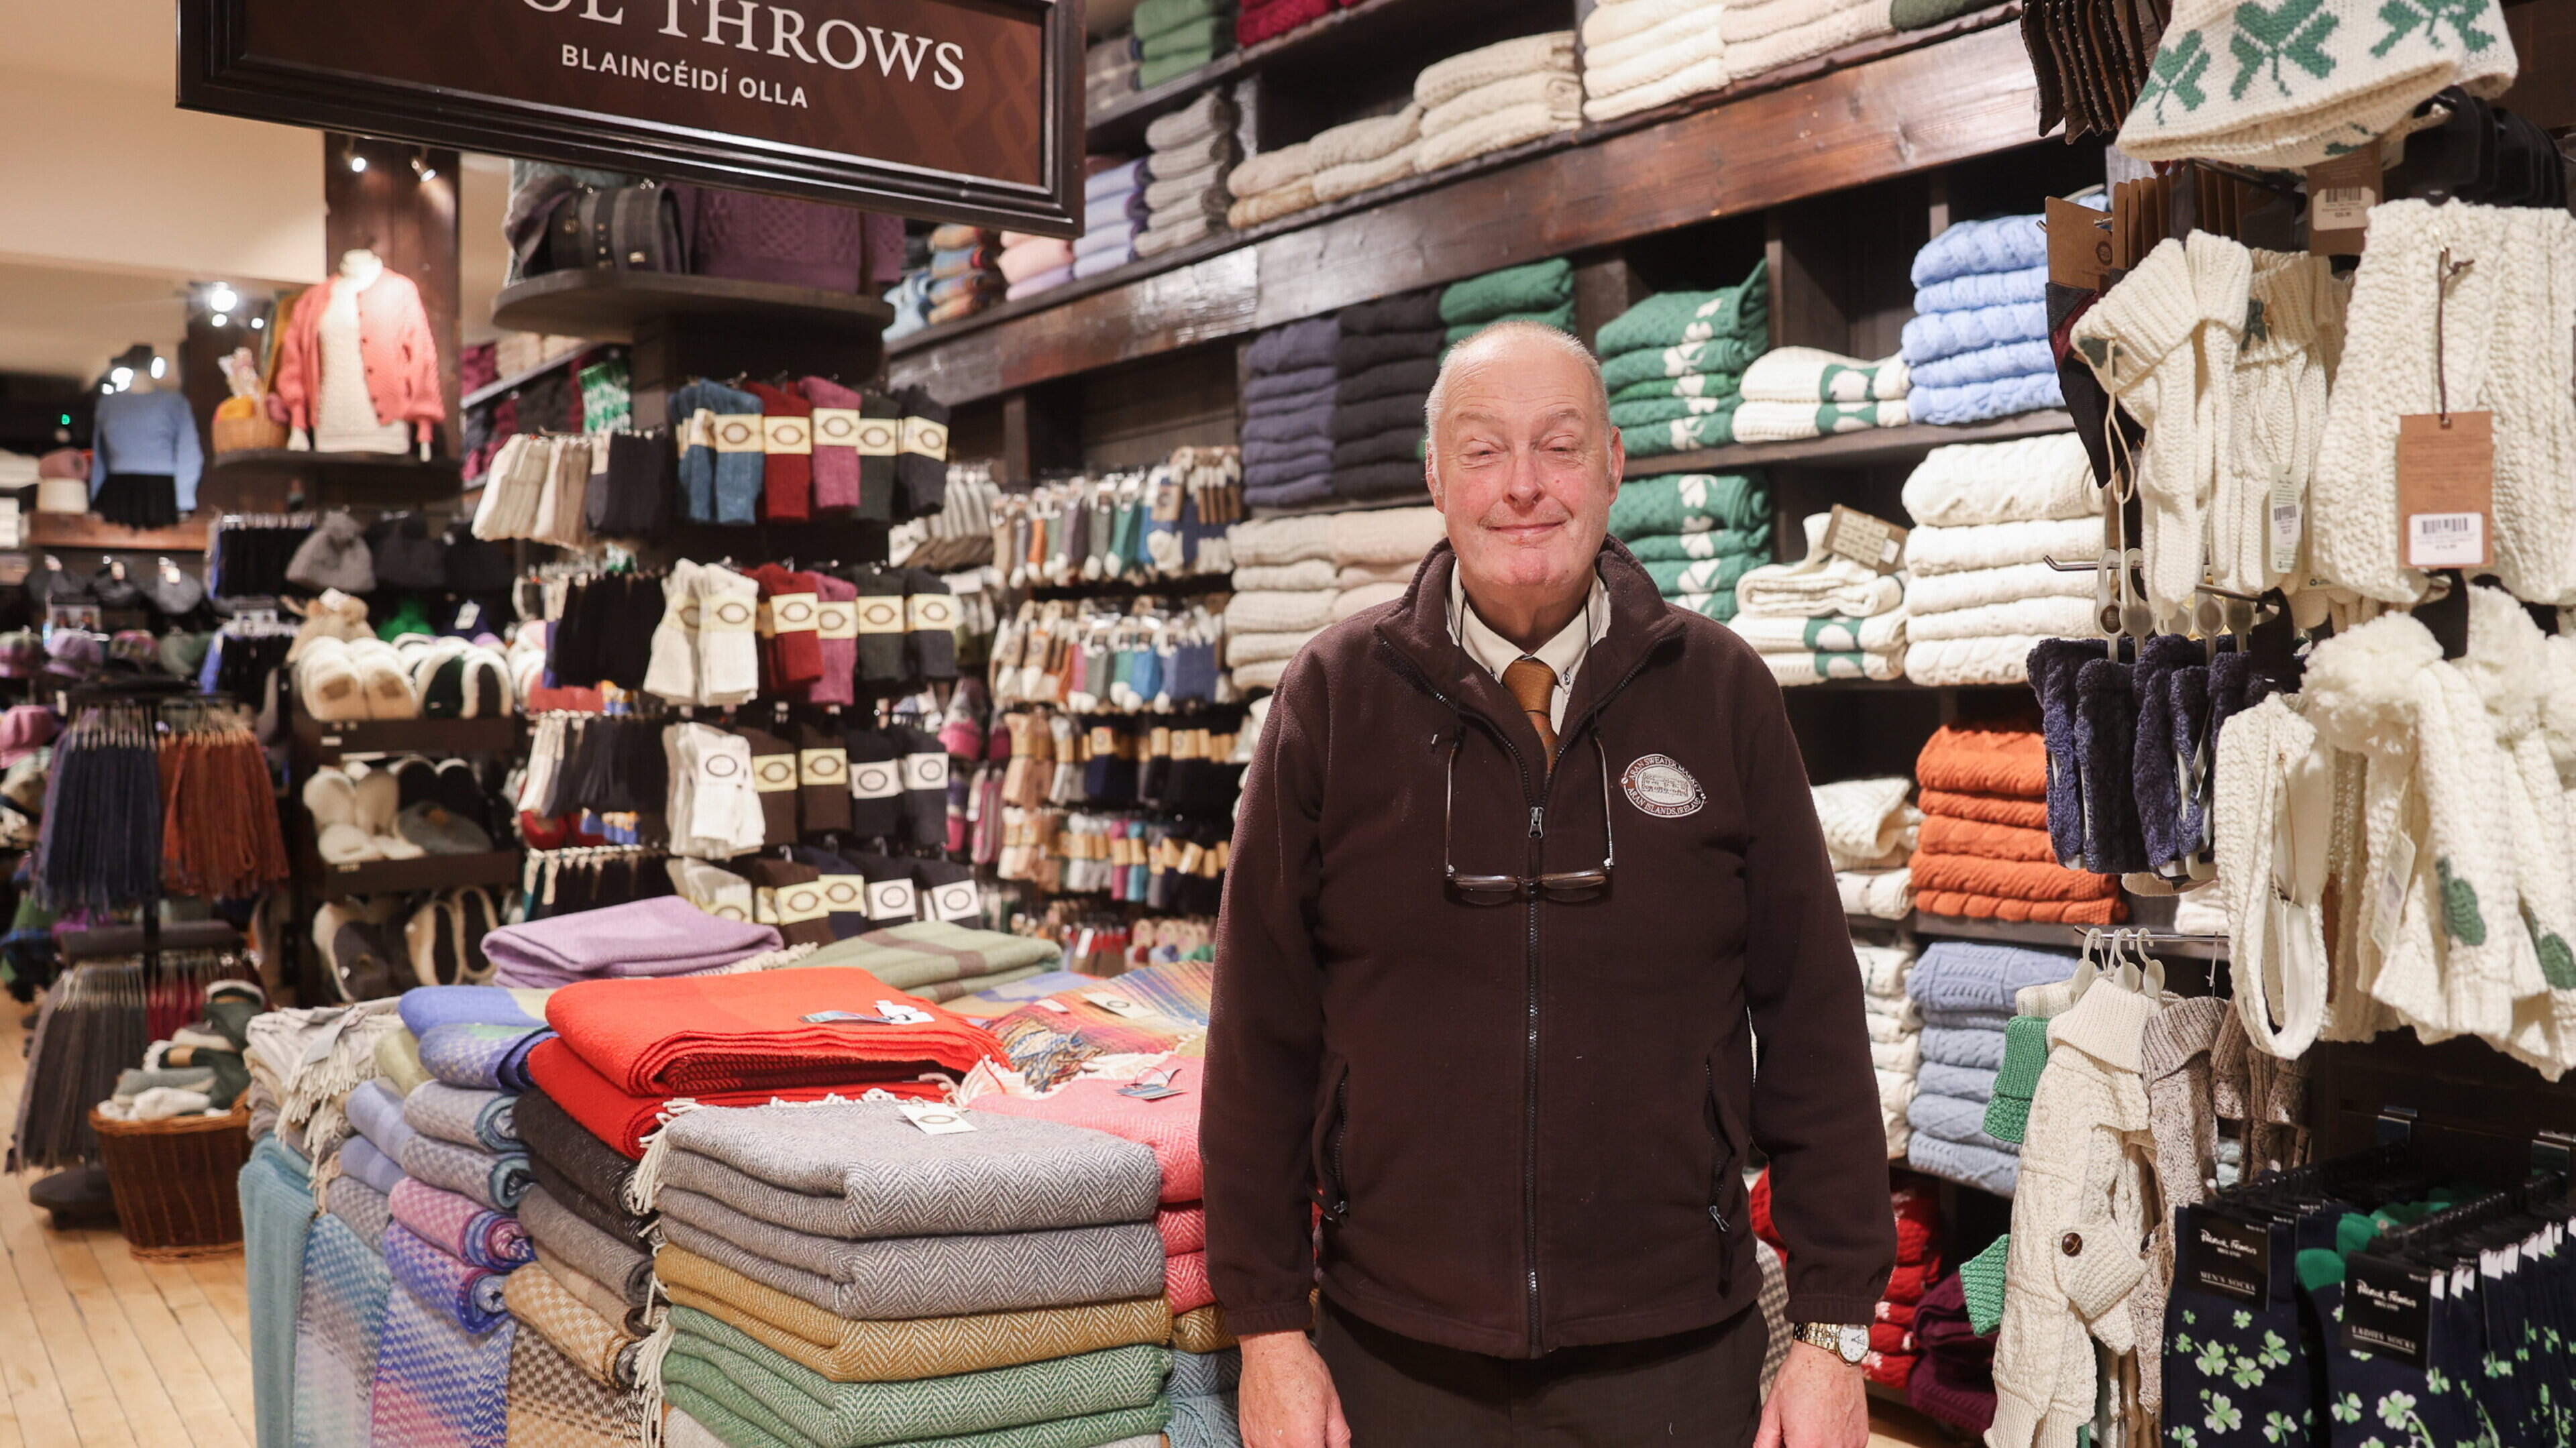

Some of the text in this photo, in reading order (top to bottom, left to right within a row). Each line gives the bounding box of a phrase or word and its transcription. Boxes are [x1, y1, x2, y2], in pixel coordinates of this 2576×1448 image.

[658, 0, 965, 91] THROWS
[561, 44, 808, 109] BLAINCÉIDÍ OLLA
[1629, 759, 1645, 781] ARAN
[1644, 757, 1677, 769] SWEATER
[1627, 787, 1645, 807] ARAN
[1677, 797, 1702, 816] IRELAND
